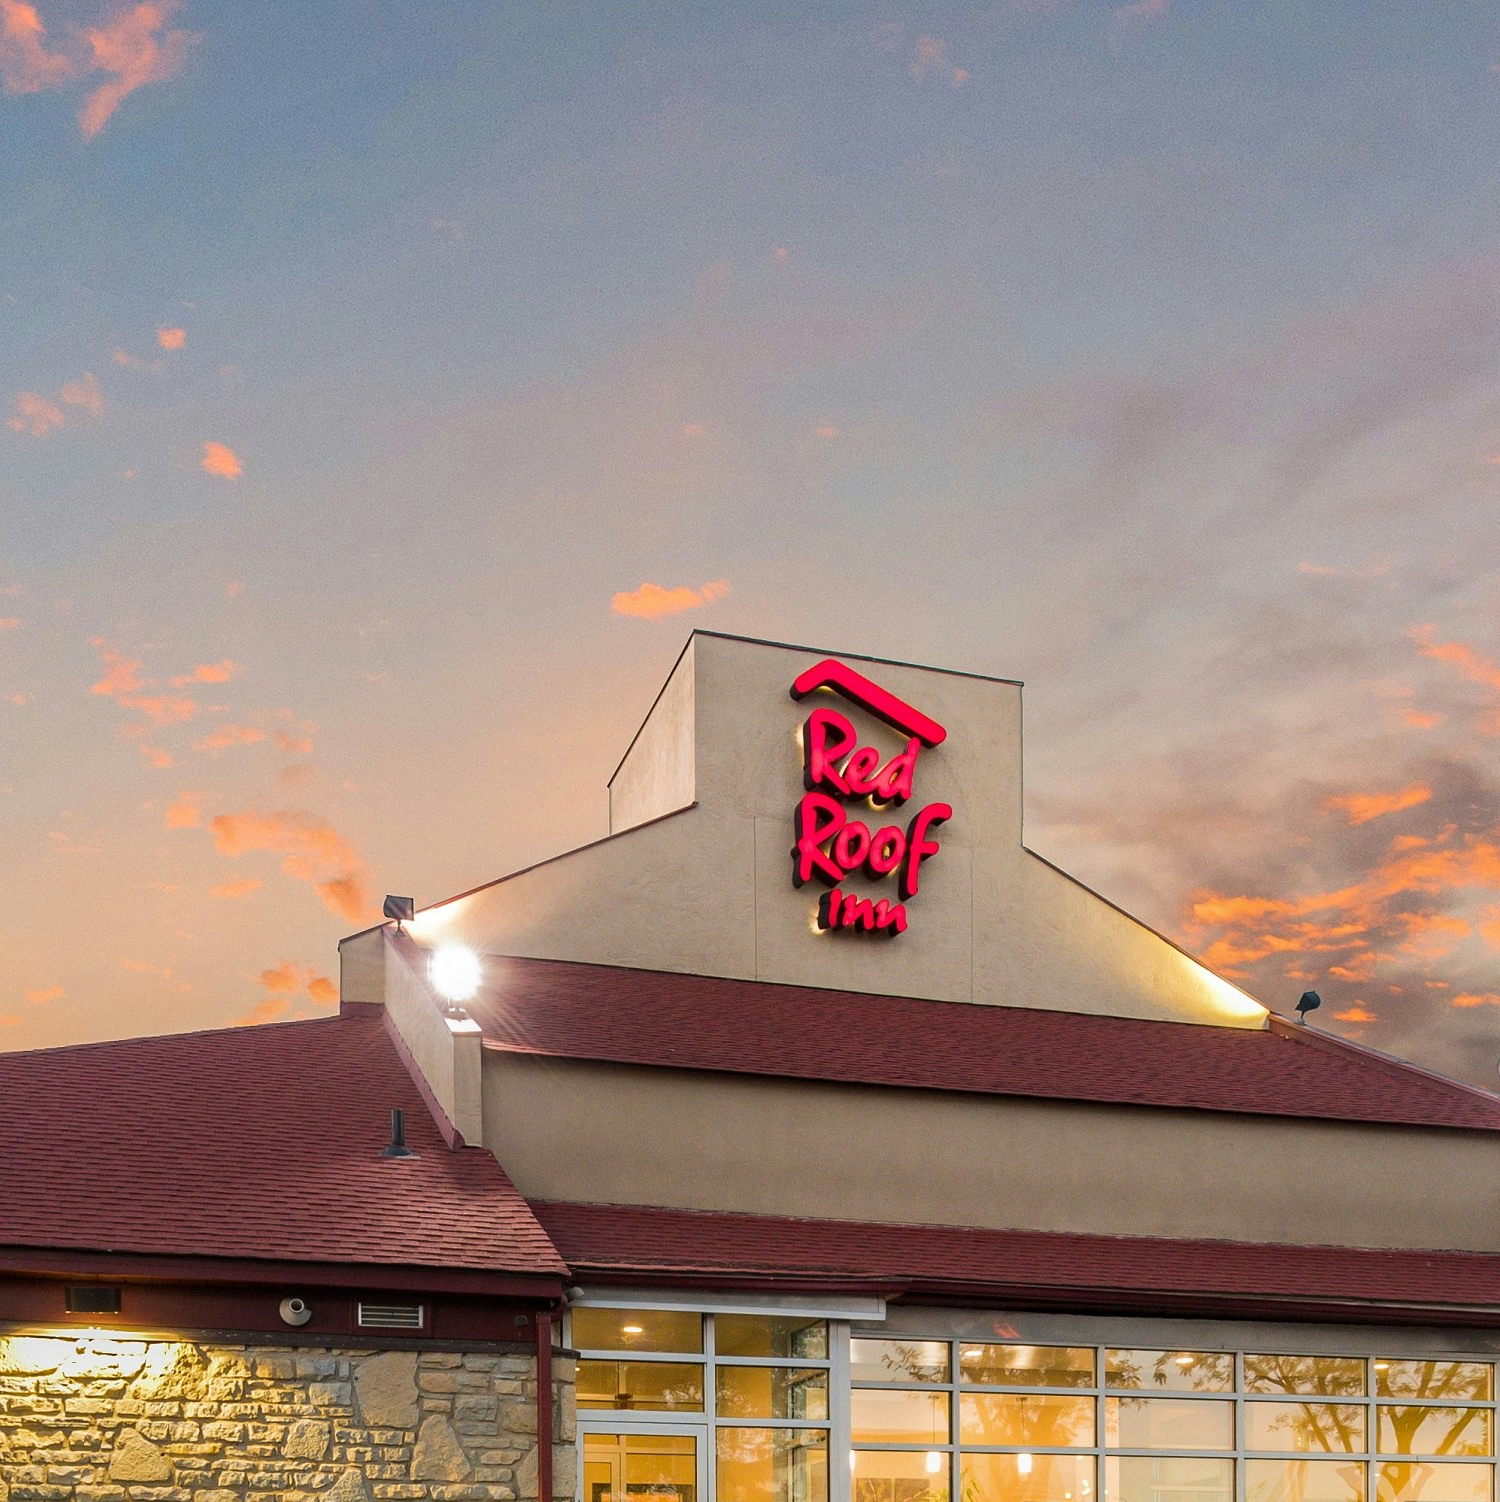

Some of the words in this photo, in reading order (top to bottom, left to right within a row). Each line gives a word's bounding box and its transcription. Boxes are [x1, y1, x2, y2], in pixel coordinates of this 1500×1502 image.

[803, 708, 921, 804] Red
[793, 792, 952, 898] Roof
[819, 889, 908, 935] Inn
